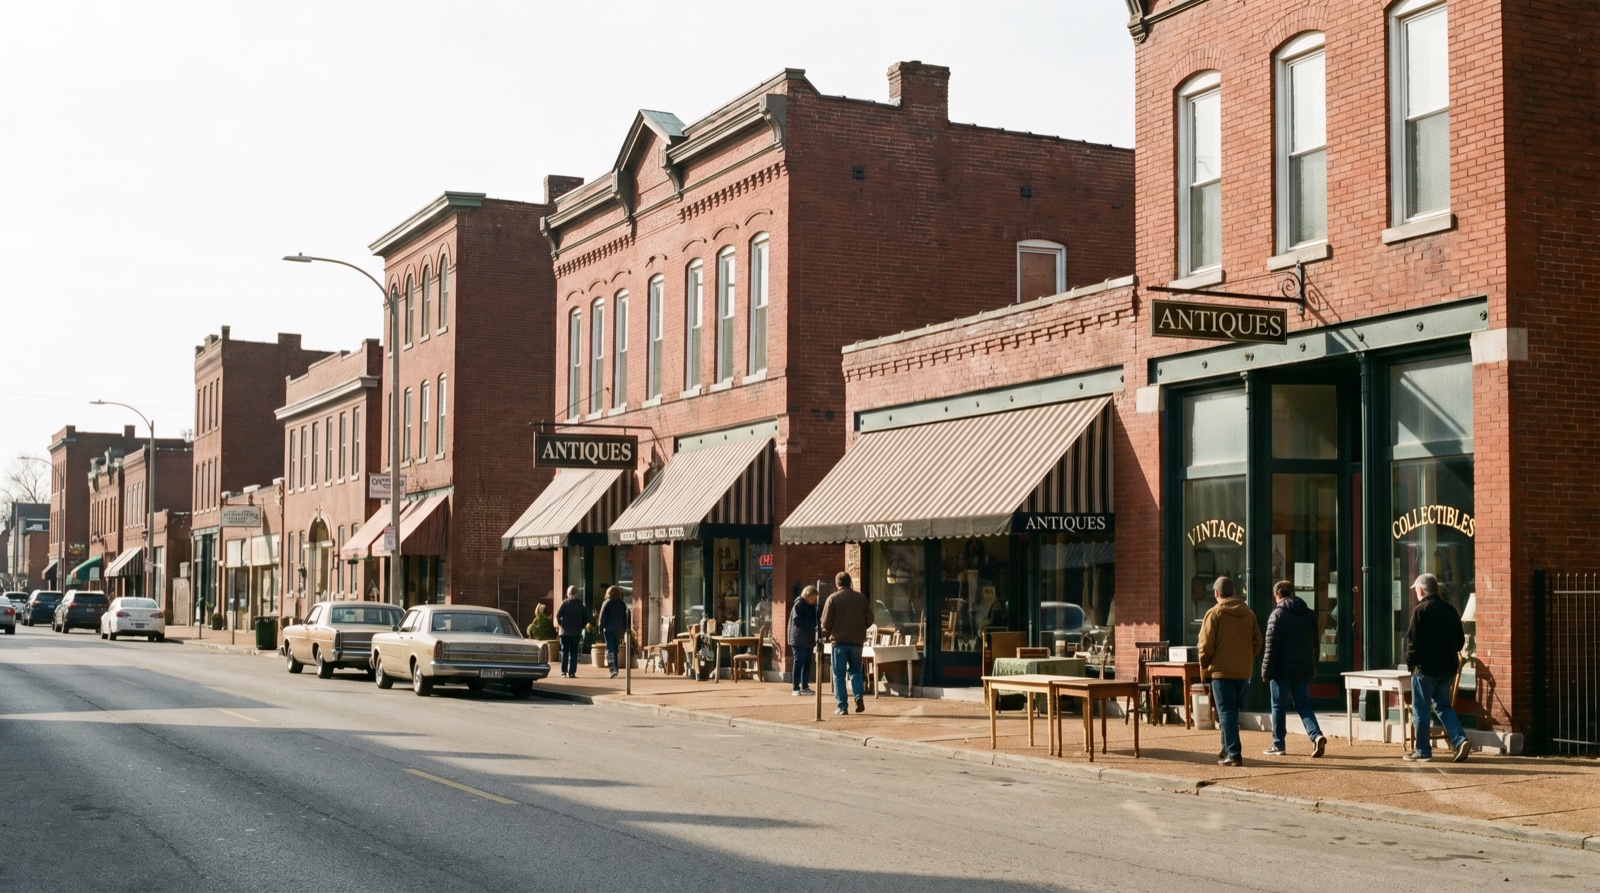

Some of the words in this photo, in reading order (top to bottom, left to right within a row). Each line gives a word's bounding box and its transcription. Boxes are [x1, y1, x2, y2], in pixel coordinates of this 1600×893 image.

[1158, 308, 1282, 339] ANTIQUES
[541, 441, 632, 465] ANTIQUES
[863, 522, 903, 538] VINTAGE
[1025, 516, 1106, 533] ANTIQUES
[1187, 519, 1245, 546] VINTAGE
[1392, 504, 1476, 539] COLLECTIBLES
